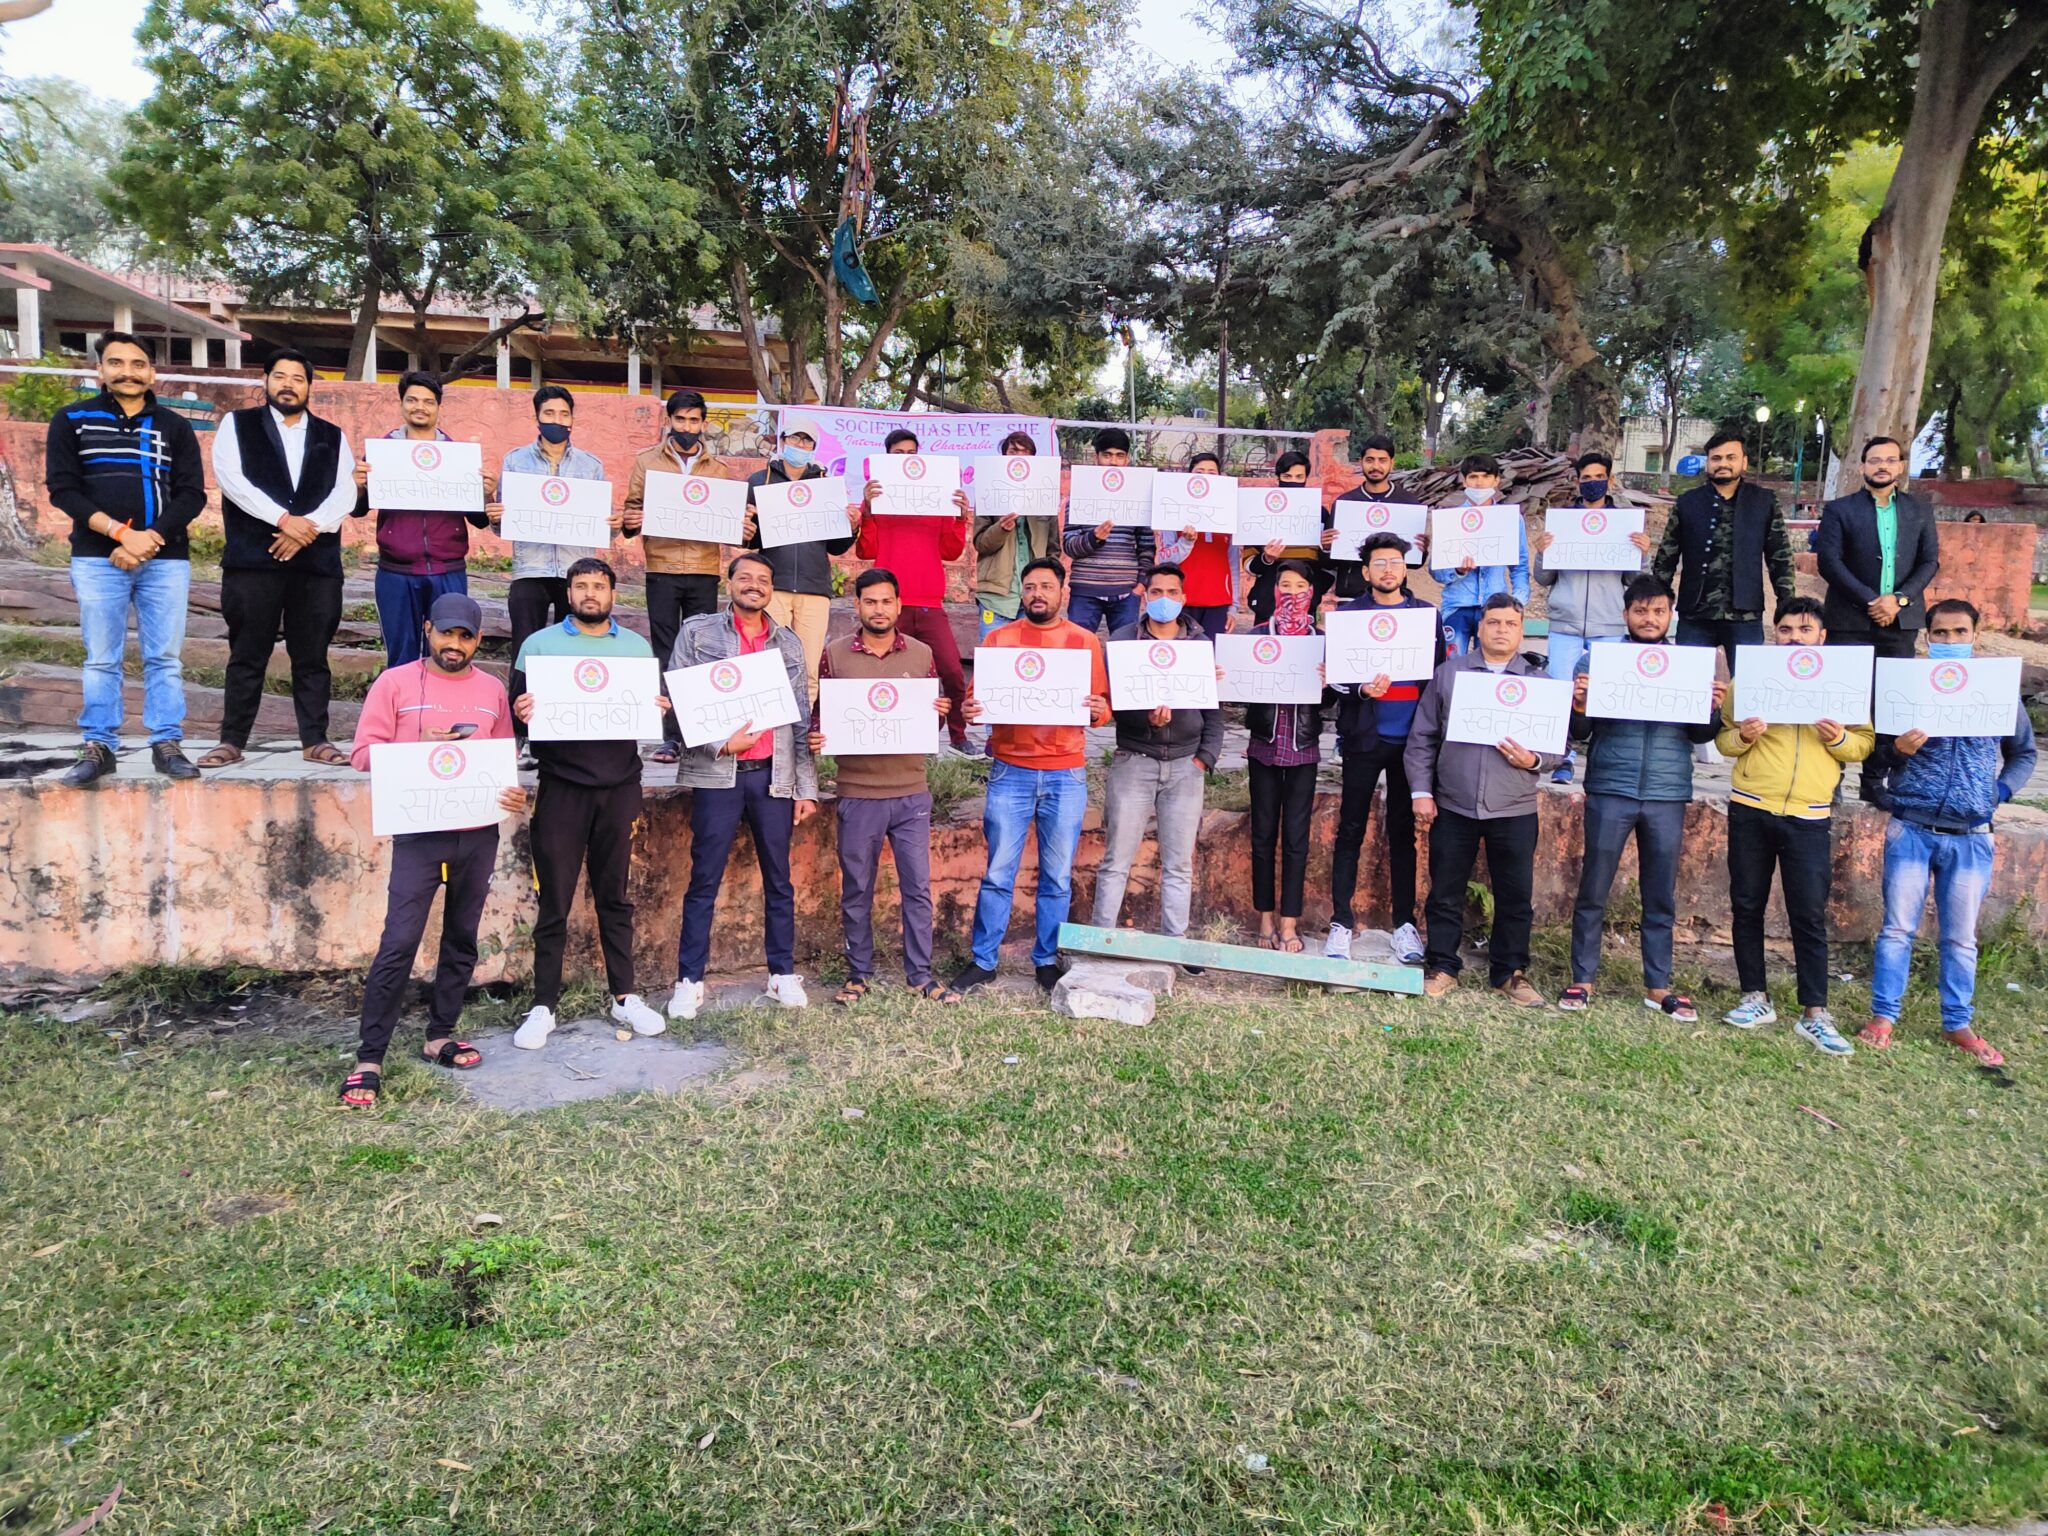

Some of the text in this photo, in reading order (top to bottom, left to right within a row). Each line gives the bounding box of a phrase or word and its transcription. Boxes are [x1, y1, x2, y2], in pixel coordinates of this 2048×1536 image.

[916, 421, 951, 437] HAS
[957, 421, 991, 437] EVE
[930, 439, 995, 452] Charitable
[513, 508, 601, 538] समानता
[1159, 496, 1228, 525] निडर
[1441, 535, 1506, 561] सबल
[1343, 646, 1423, 675] सजग
[1123, 664, 1211, 704] सहिष्णु
[1228, 663, 1305, 698] समर्थ
[1597, 670, 1708, 713] अधिकार
[692, 686, 785, 733] सम्मान
[840, 706, 914, 747] शिक्षा
